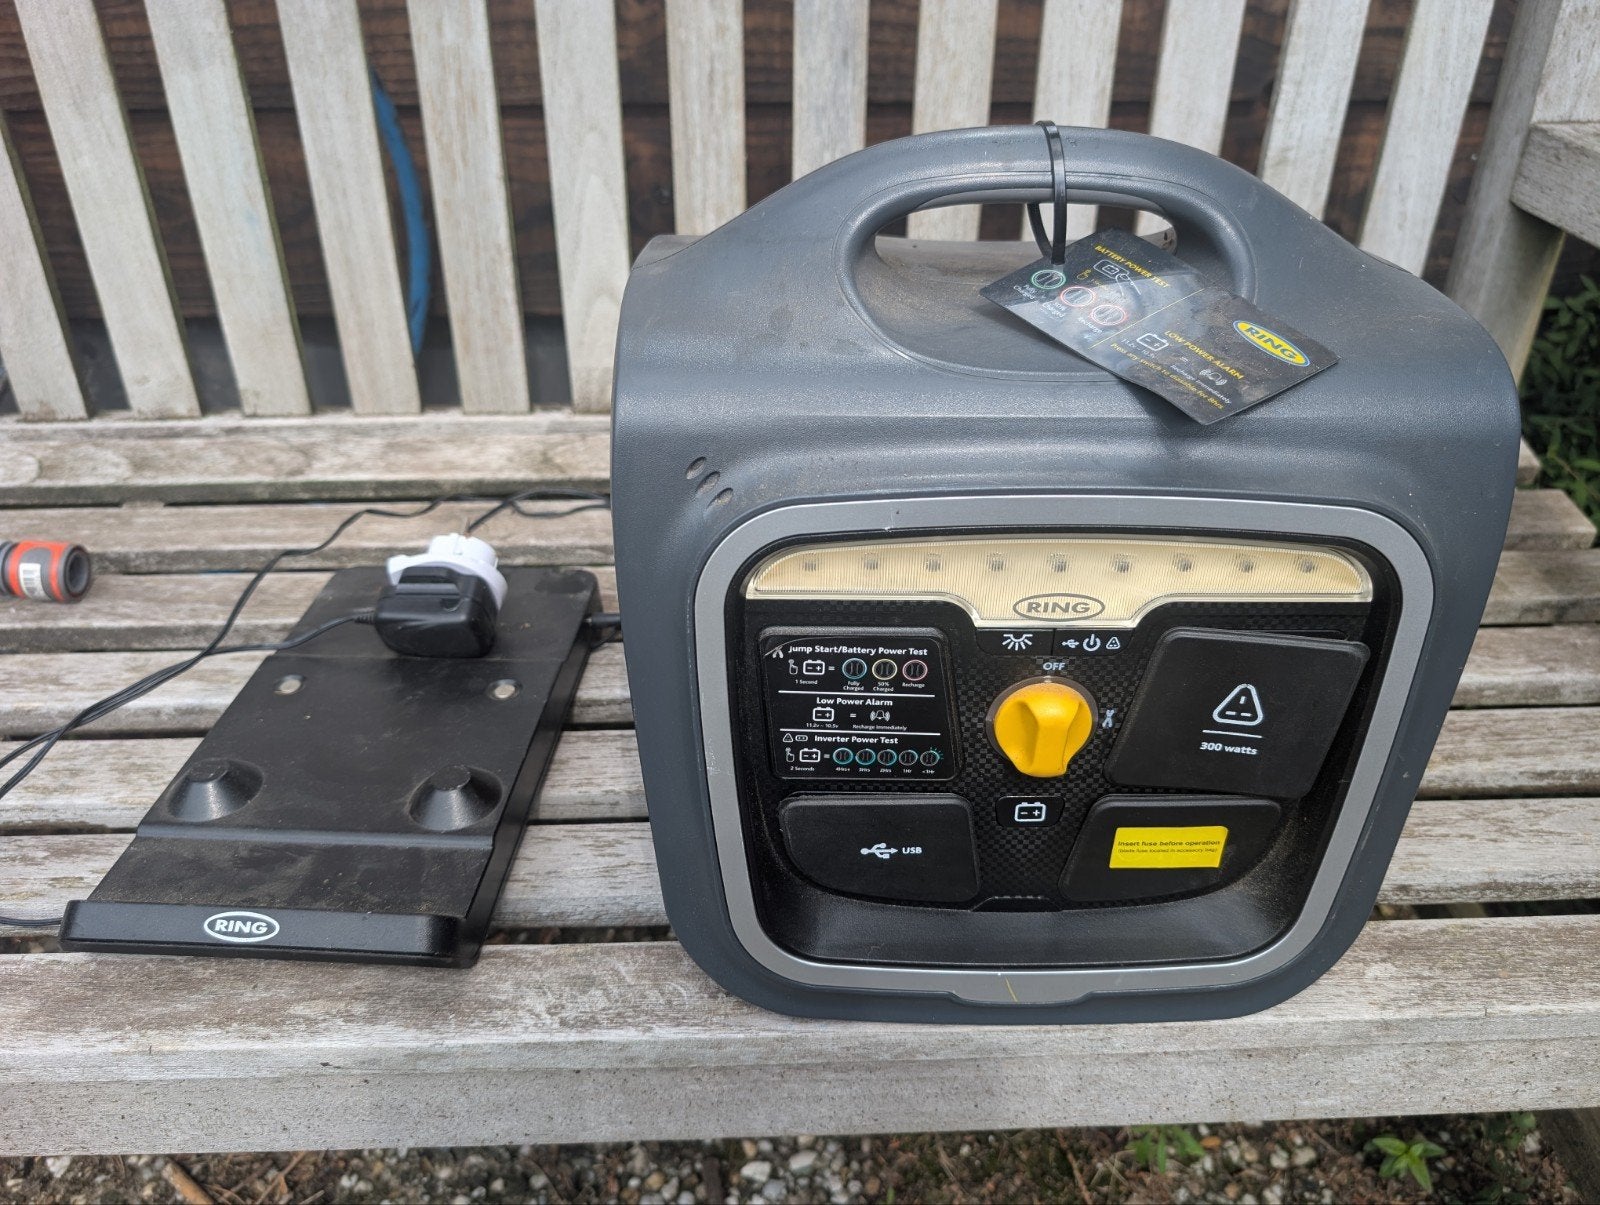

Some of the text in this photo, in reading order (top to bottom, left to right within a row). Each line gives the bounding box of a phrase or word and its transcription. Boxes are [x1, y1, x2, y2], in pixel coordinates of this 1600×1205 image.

[1094, 245, 1169, 288] BATTERY POWER TEST
[1244, 326, 1298, 359] RING
[1164, 330, 1244, 379] LOW POWER ALARM
[1026, 602, 1091, 613] RING
[788, 645, 928, 656] Jump Start/Battery Power Test
[1043, 662, 1066, 670] OFF
[816, 696, 893, 706] Low Power Alarm
[814, 735, 899, 745] Inverter Power Test
[1200, 741, 1259, 756] 300 watts
[902, 846, 923, 855] USB
[215, 919, 268, 935] RING
